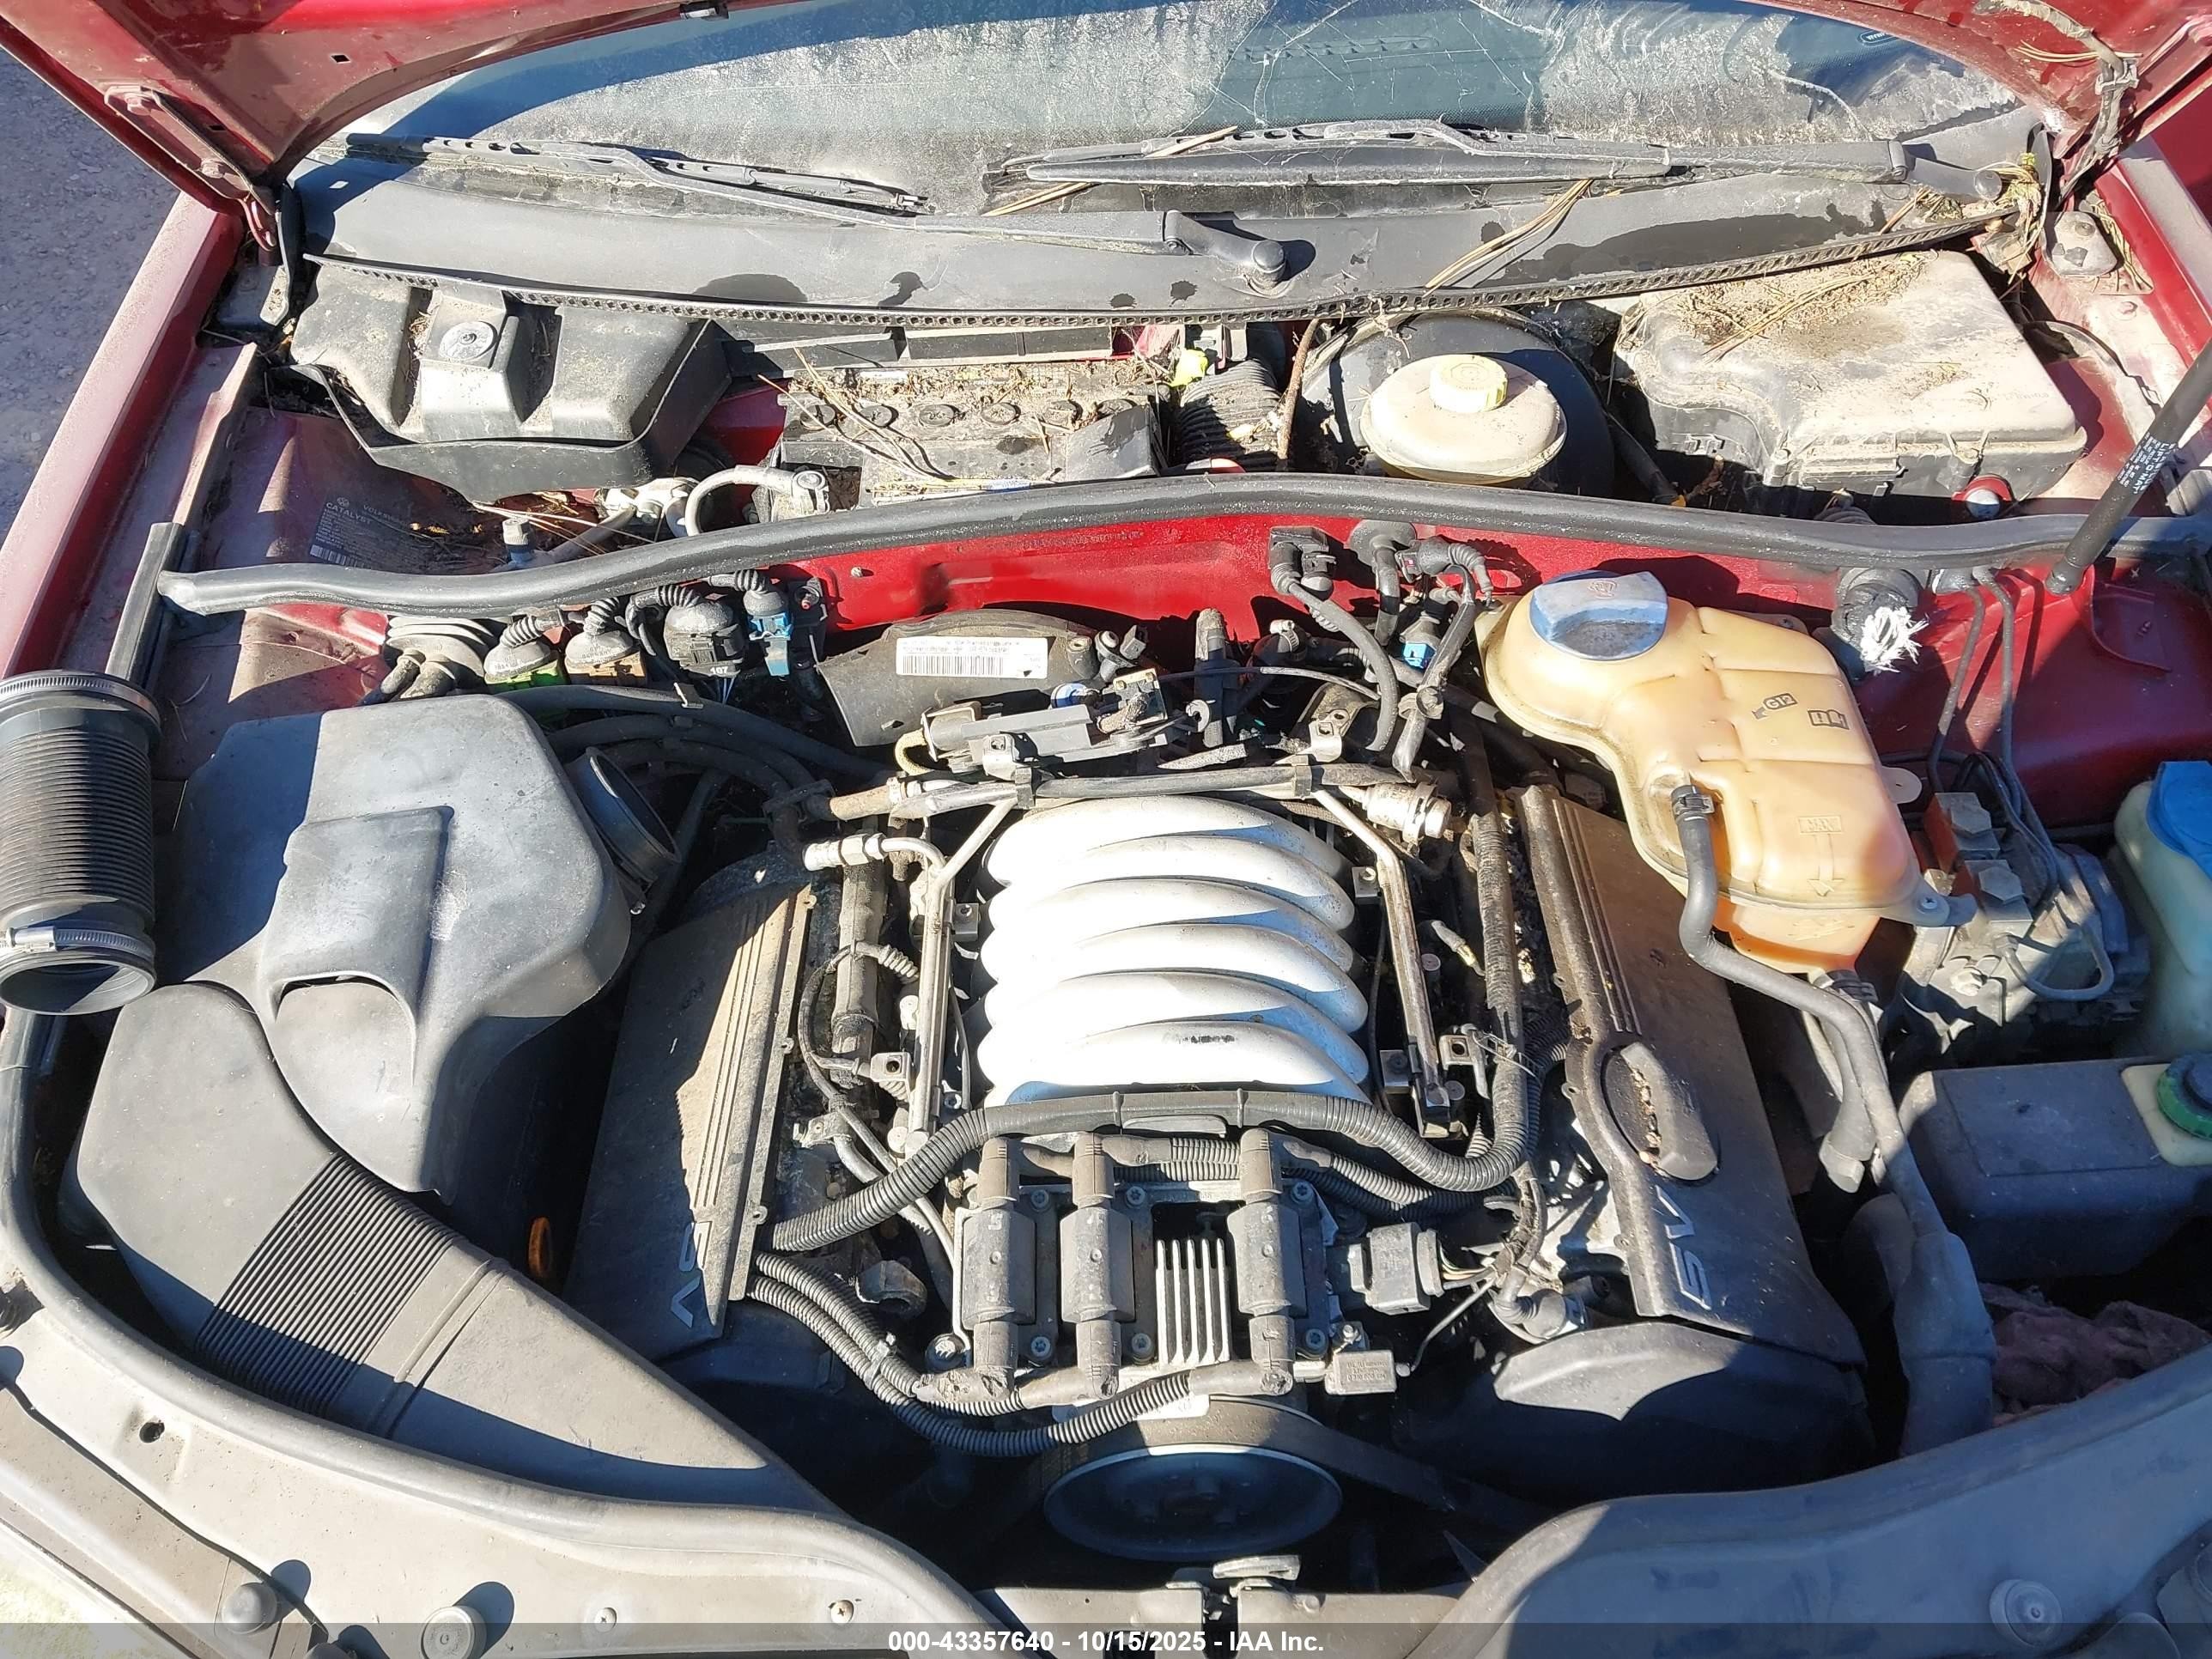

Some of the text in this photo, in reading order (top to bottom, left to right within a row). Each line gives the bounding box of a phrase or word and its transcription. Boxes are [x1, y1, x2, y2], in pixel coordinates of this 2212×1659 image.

[325, 501, 372, 525] CATALYST
[709, 665, 729, 676] 107
[1765, 695, 1796, 710] G12
